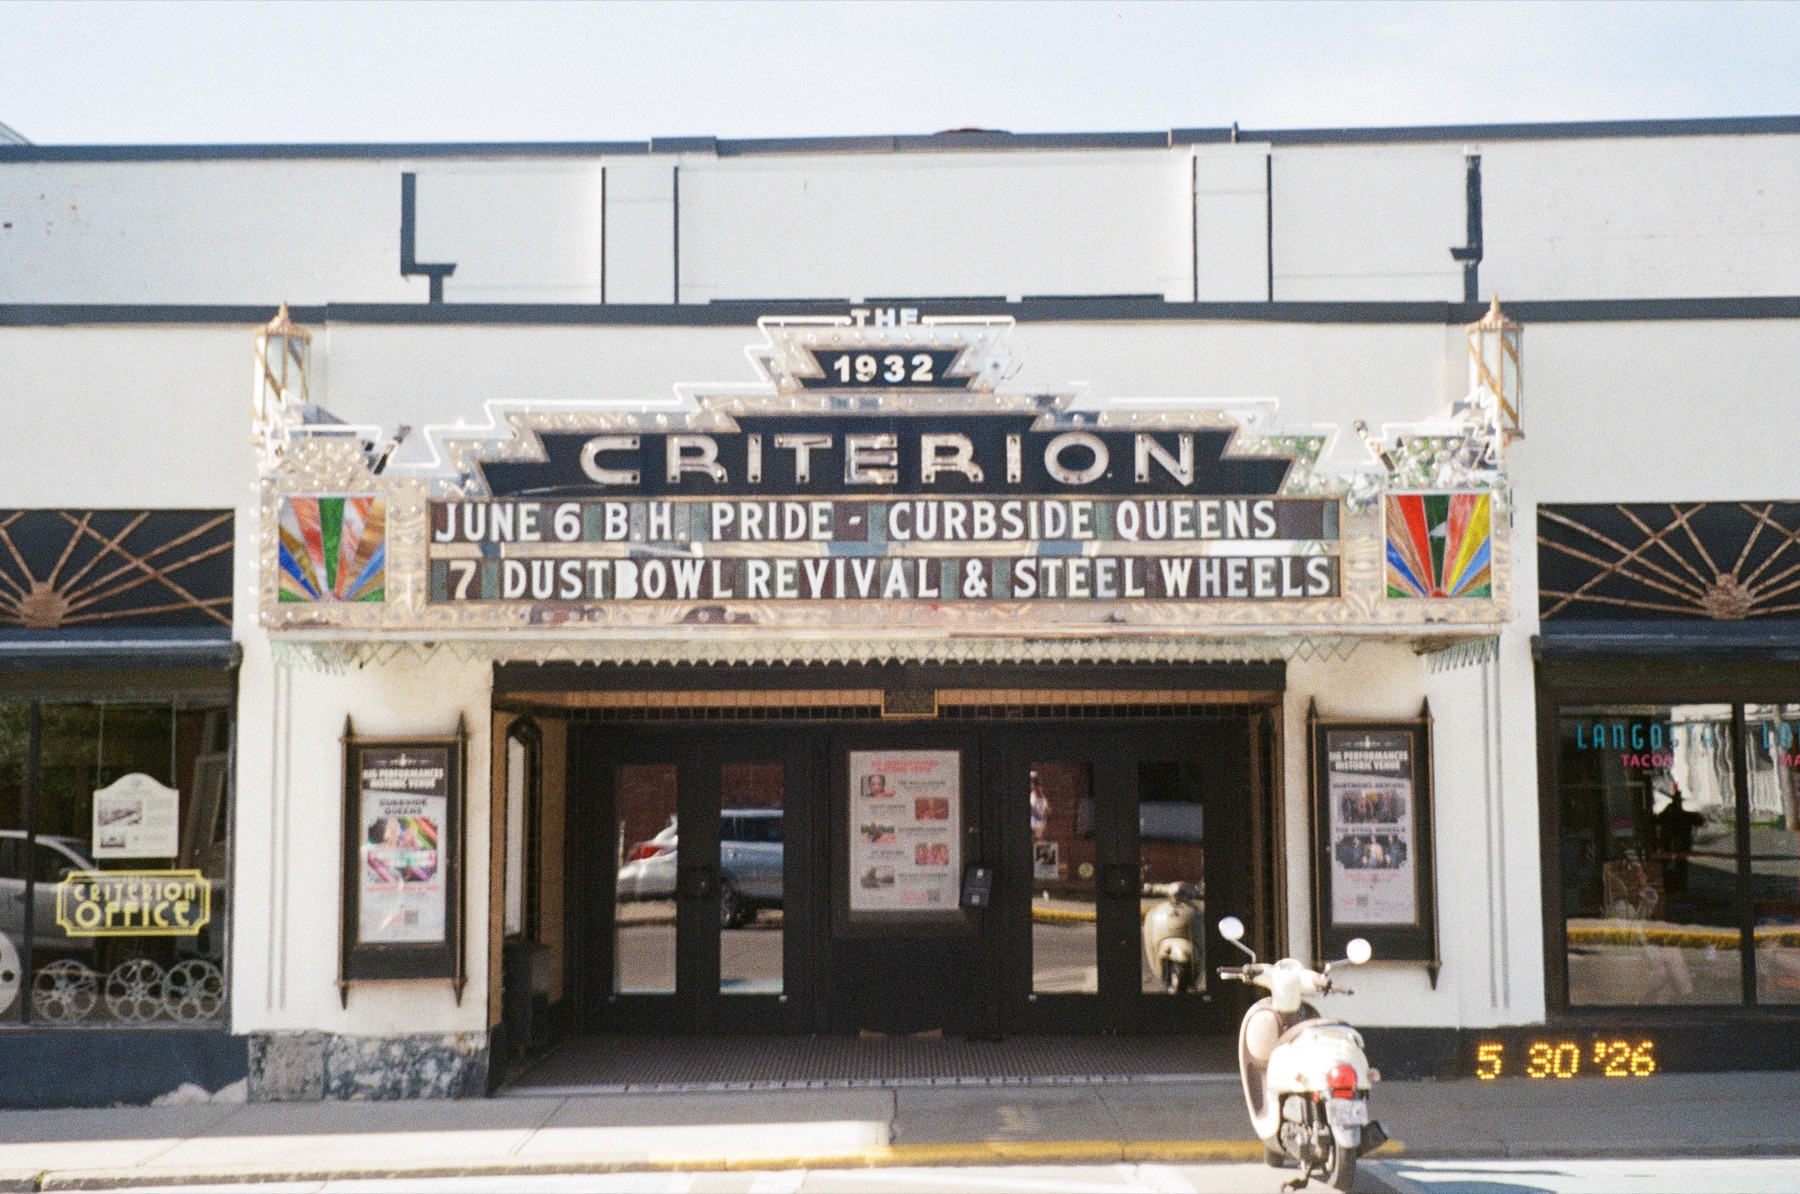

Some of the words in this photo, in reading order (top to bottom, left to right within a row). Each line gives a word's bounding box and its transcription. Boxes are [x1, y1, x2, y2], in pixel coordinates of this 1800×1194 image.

[850, 307, 918, 328] THE
[833, 354, 934, 383] 1932
[579, 432, 1195, 487] CRITERION
[434, 502, 541, 543] JUNE
[553, 502, 582, 543] 6
[711, 502, 834, 542] PRIDE
[888, 500, 1095, 541] CURBSIDE
[1115, 500, 1278, 542] QUEENS
[448, 560, 477, 600] 7
[503, 559, 734, 600] DUSTBOWL
[747, 557, 939, 600] REVIVAL
[962, 558, 989, 599] &
[1013, 557, 1146, 598] STEEL
[1159, 556, 1331, 598] WHEELS
[1575, 722, 1715, 750] LANGOSTA
[1620, 753, 1673, 768] TACOS
[73, 882, 196, 902] CRITERION
[75, 900, 190, 929] OFFICE
